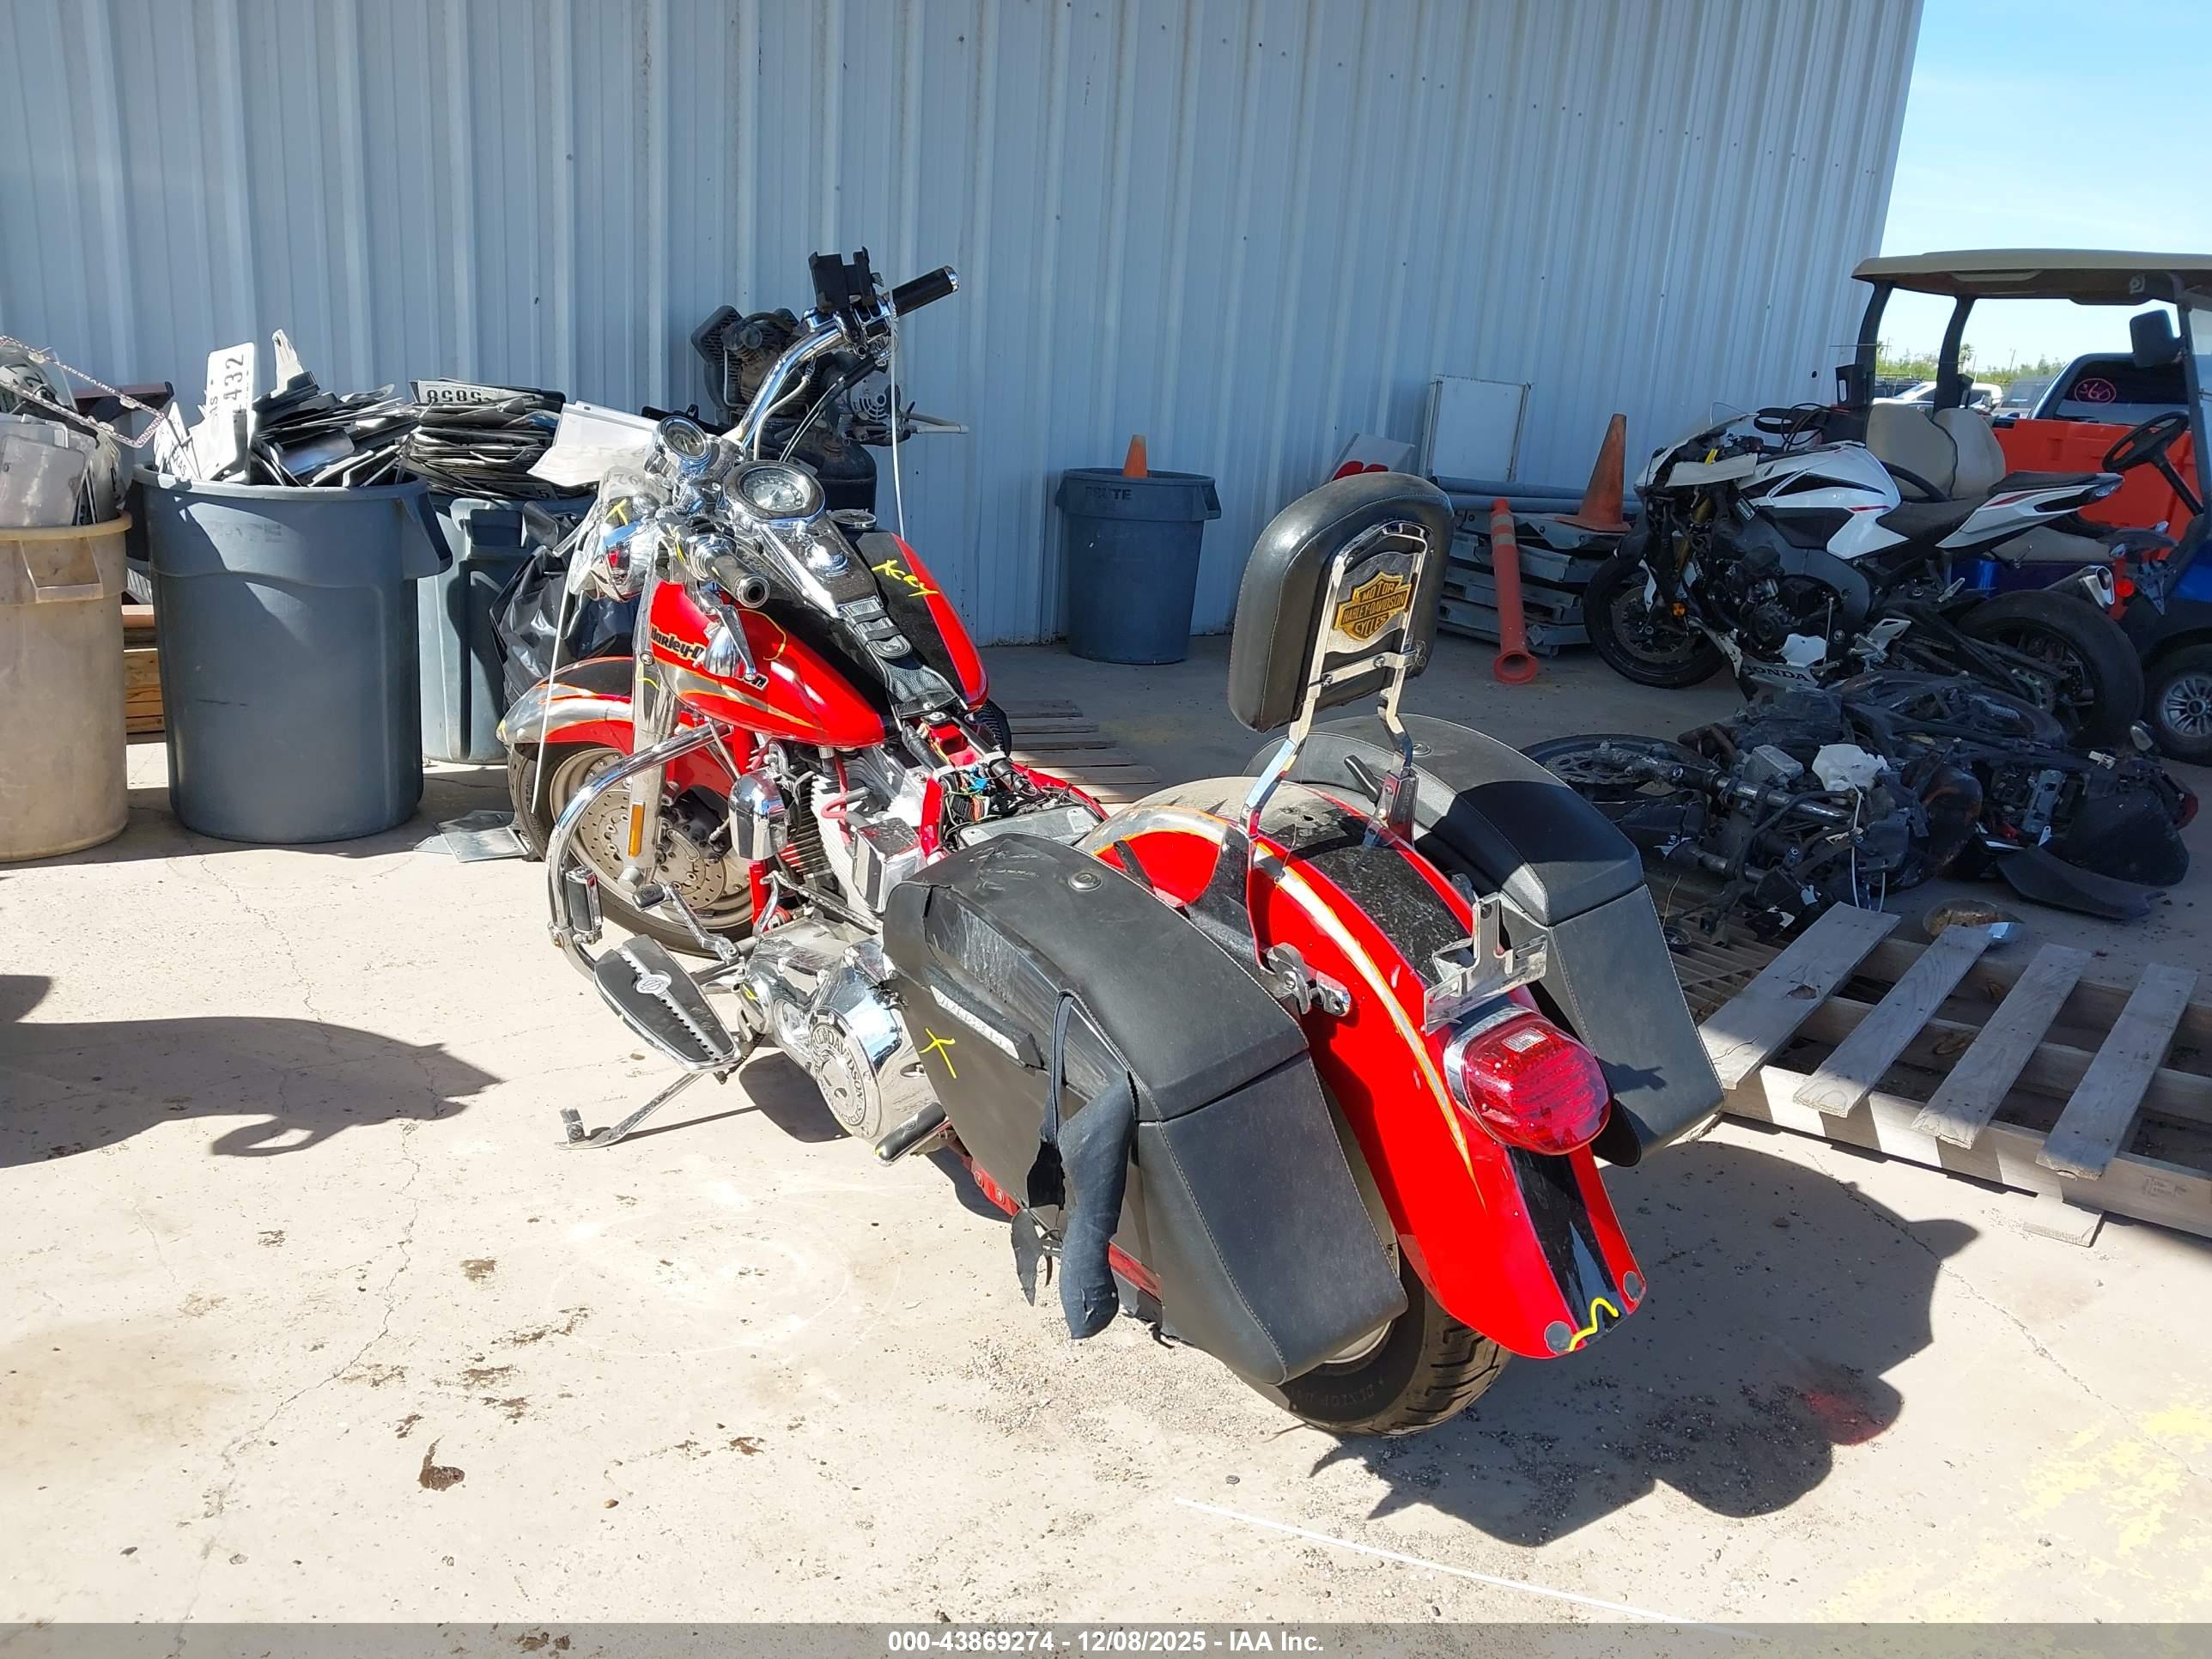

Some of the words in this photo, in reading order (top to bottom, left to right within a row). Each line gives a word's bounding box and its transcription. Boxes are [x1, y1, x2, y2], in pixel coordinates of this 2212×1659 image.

[223, 354, 245, 412] 432
[1085, 486, 1133, 500] BRTE
[1362, 581, 1395, 601] MOTOR
[1342, 592, 1406, 623] HARLEY-DAVIDSON
[1355, 615, 1388, 636] CYCLES
